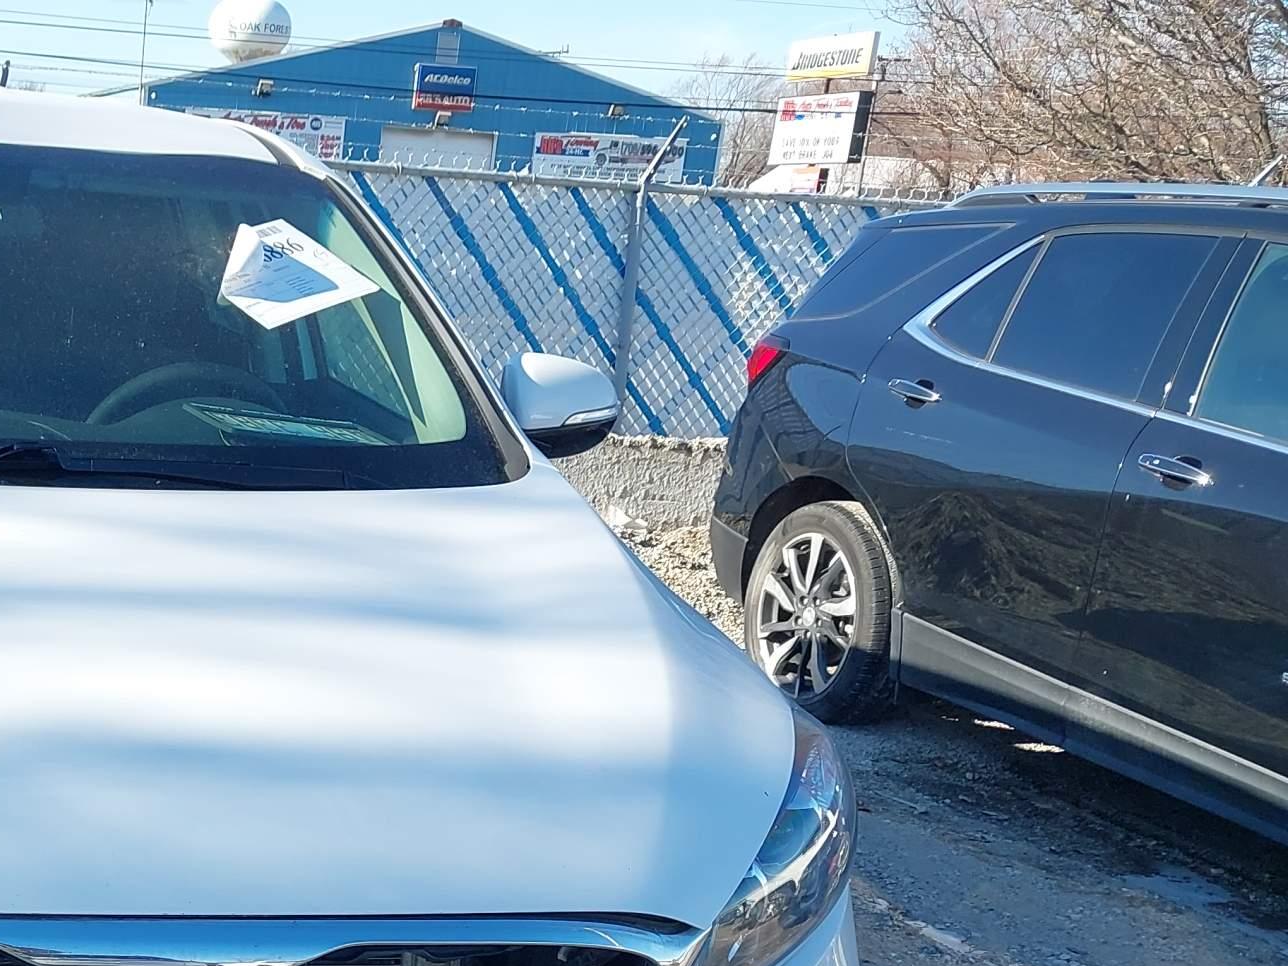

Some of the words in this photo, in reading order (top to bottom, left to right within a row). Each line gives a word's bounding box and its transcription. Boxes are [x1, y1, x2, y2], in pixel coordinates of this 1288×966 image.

[239, 22, 261, 33] OAK
[792, 47, 864, 71] BRIDGESTONE
[424, 73, 472, 85] ACDelco
[442, 94, 470, 107] AUTO
